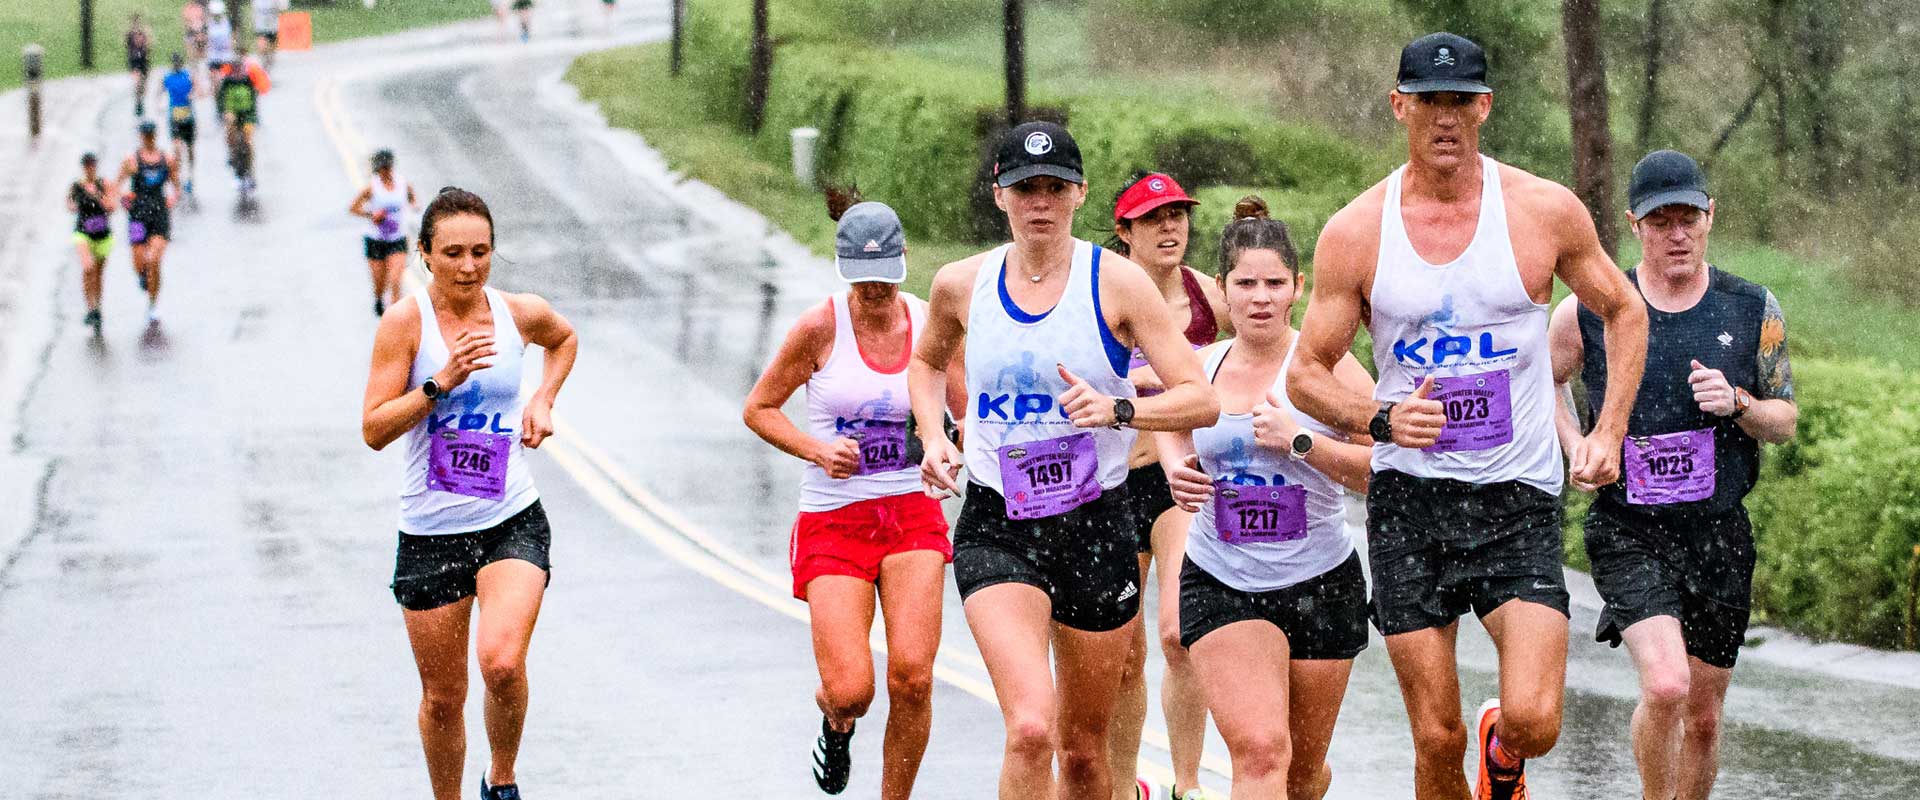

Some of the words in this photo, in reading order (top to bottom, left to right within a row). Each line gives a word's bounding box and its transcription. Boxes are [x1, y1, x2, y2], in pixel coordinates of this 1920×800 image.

[1393, 332, 1518, 365] KPL
[428, 412, 513, 435] KPL
[451, 450, 491, 472] 1246
[863, 443, 899, 464] 1244
[1646, 453, 1694, 476] 1025
[1026, 460, 1072, 488] 1497
[1238, 509, 1278, 530] 1217
